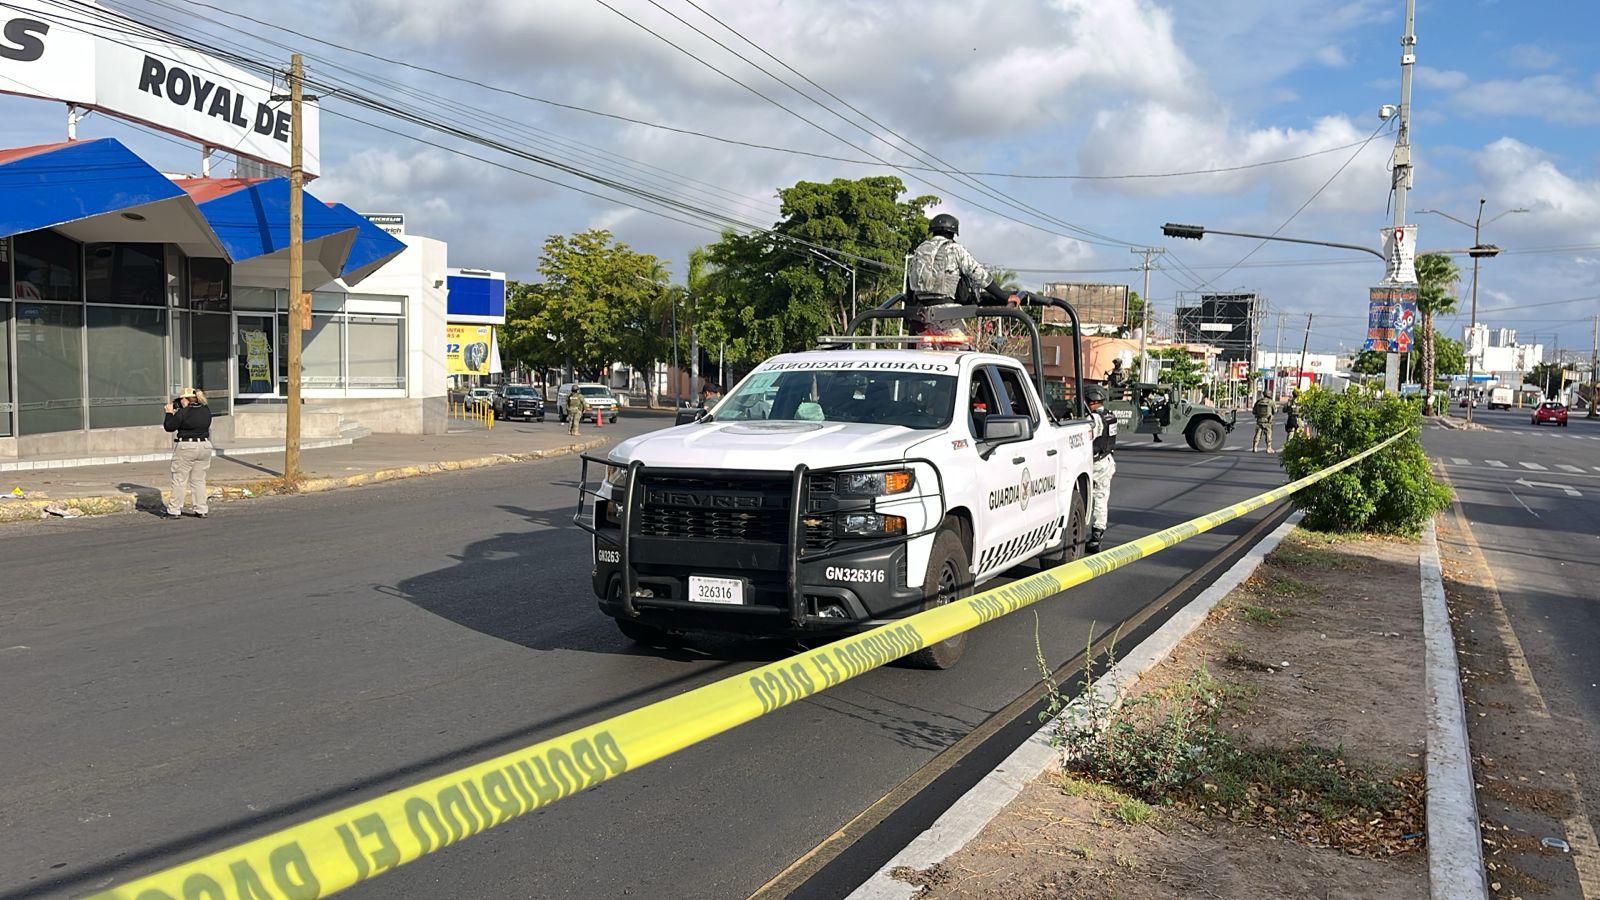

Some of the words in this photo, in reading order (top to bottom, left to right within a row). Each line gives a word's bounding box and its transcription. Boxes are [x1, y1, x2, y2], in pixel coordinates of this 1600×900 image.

[0, 18, 50, 62] S
[138, 54, 248, 128] ROYAL
[254, 102, 292, 143] DE
[989, 484, 1020, 510] GUARDIA
[1030, 474, 1056, 498] NACIONAL
[598, 549, 621, 563] GN3263
[825, 566, 885, 583] GN326316
[698, 585, 732, 599] 326316
